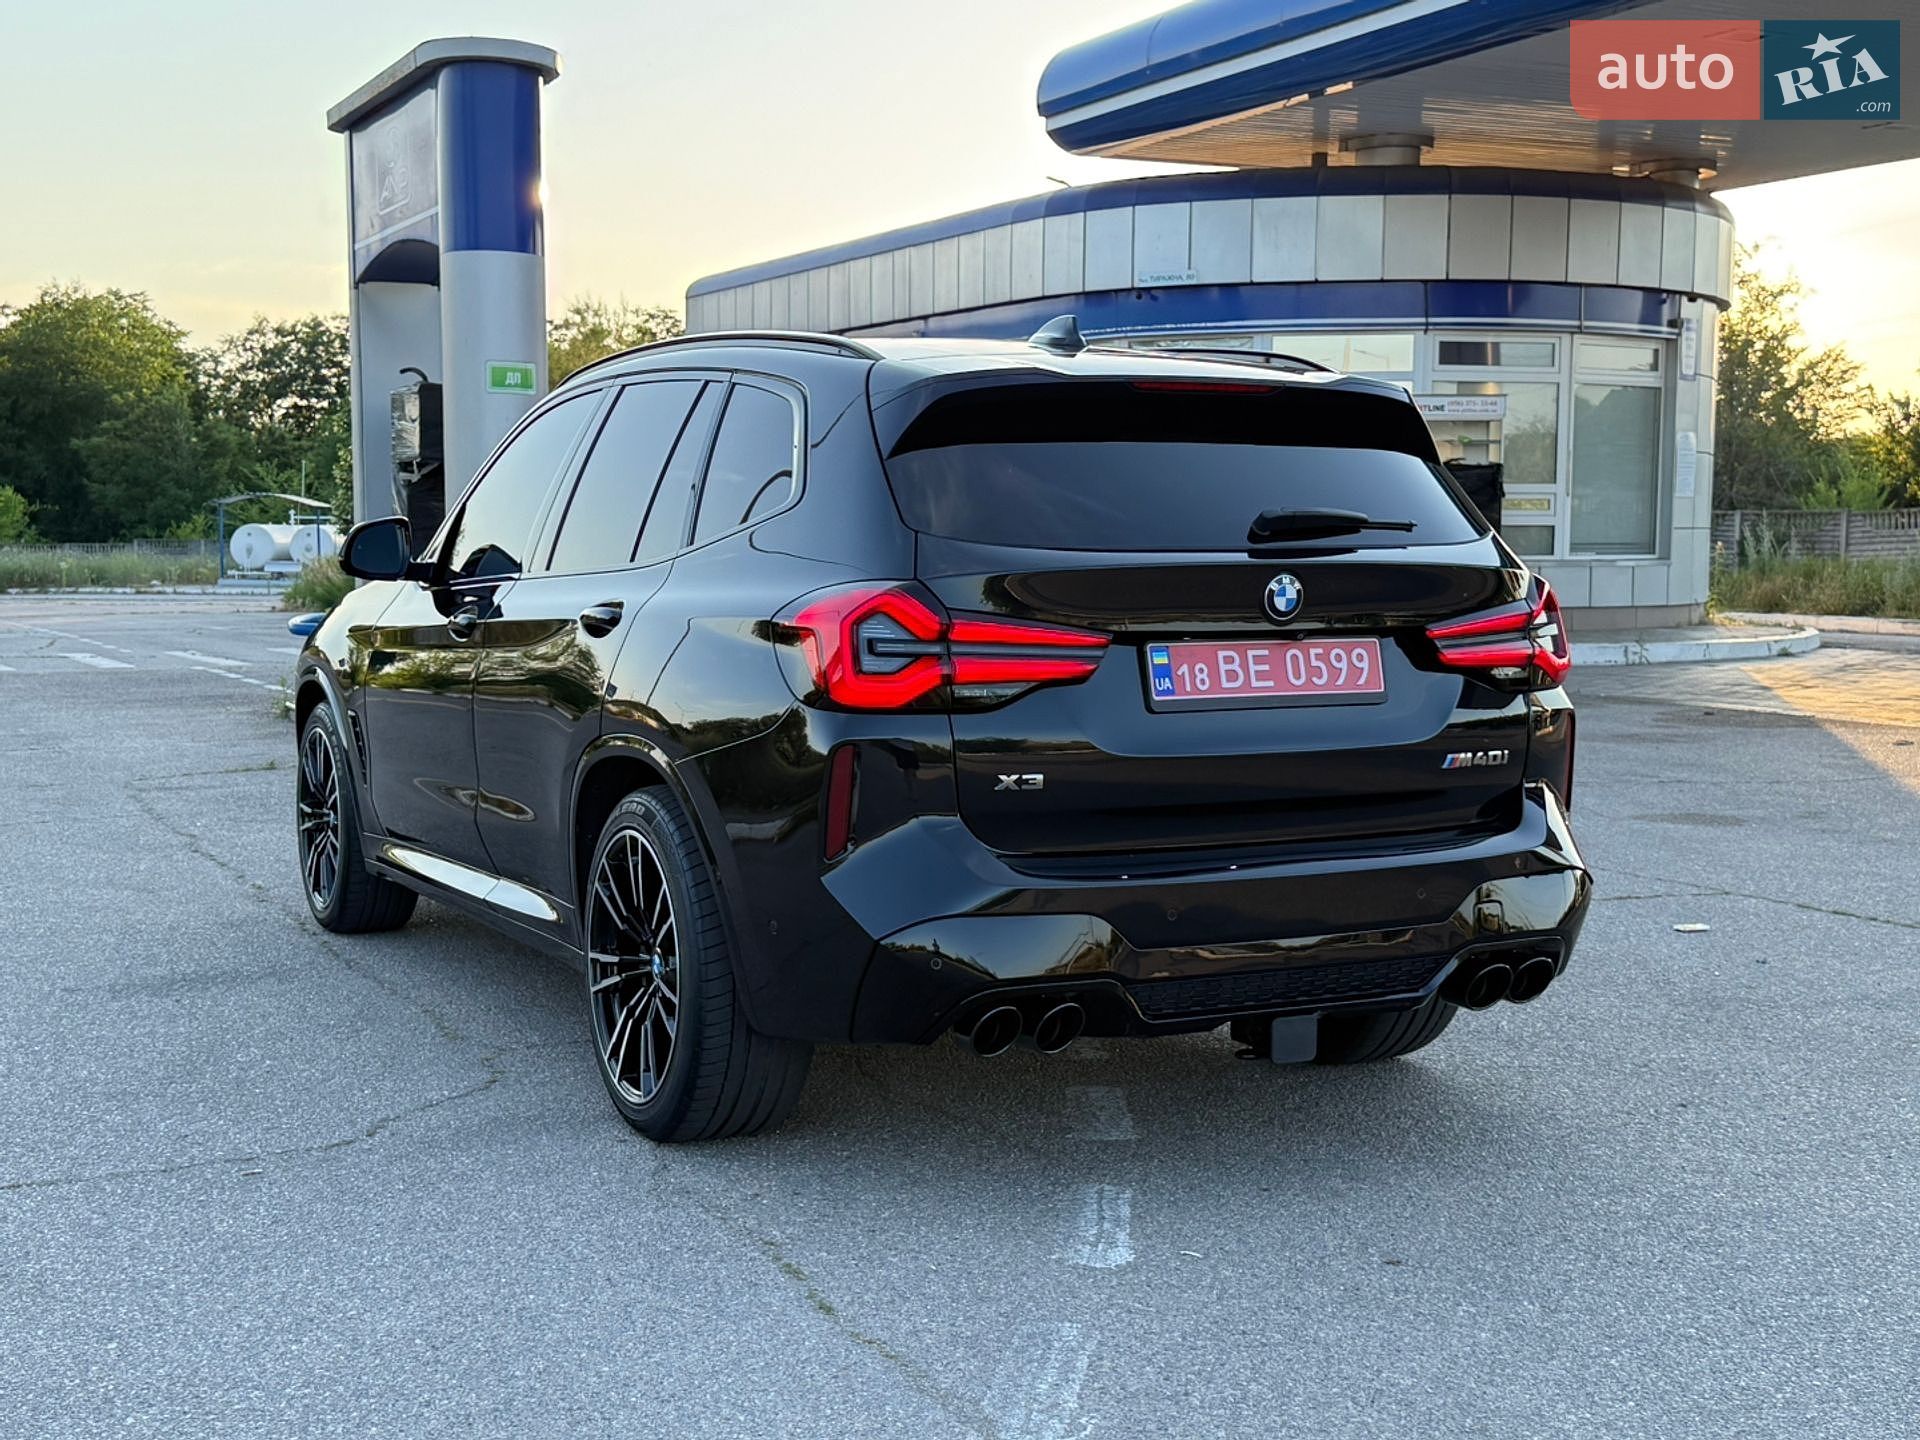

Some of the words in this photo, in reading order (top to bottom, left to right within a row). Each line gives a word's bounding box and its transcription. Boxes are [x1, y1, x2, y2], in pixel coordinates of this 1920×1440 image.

[1177, 663, 1210, 691] 18
[1217, 649, 1274, 688] BE
[1285, 647, 1369, 686] 0599
[1155, 678, 1172, 691] UA
[994, 774, 1044, 790] X3
